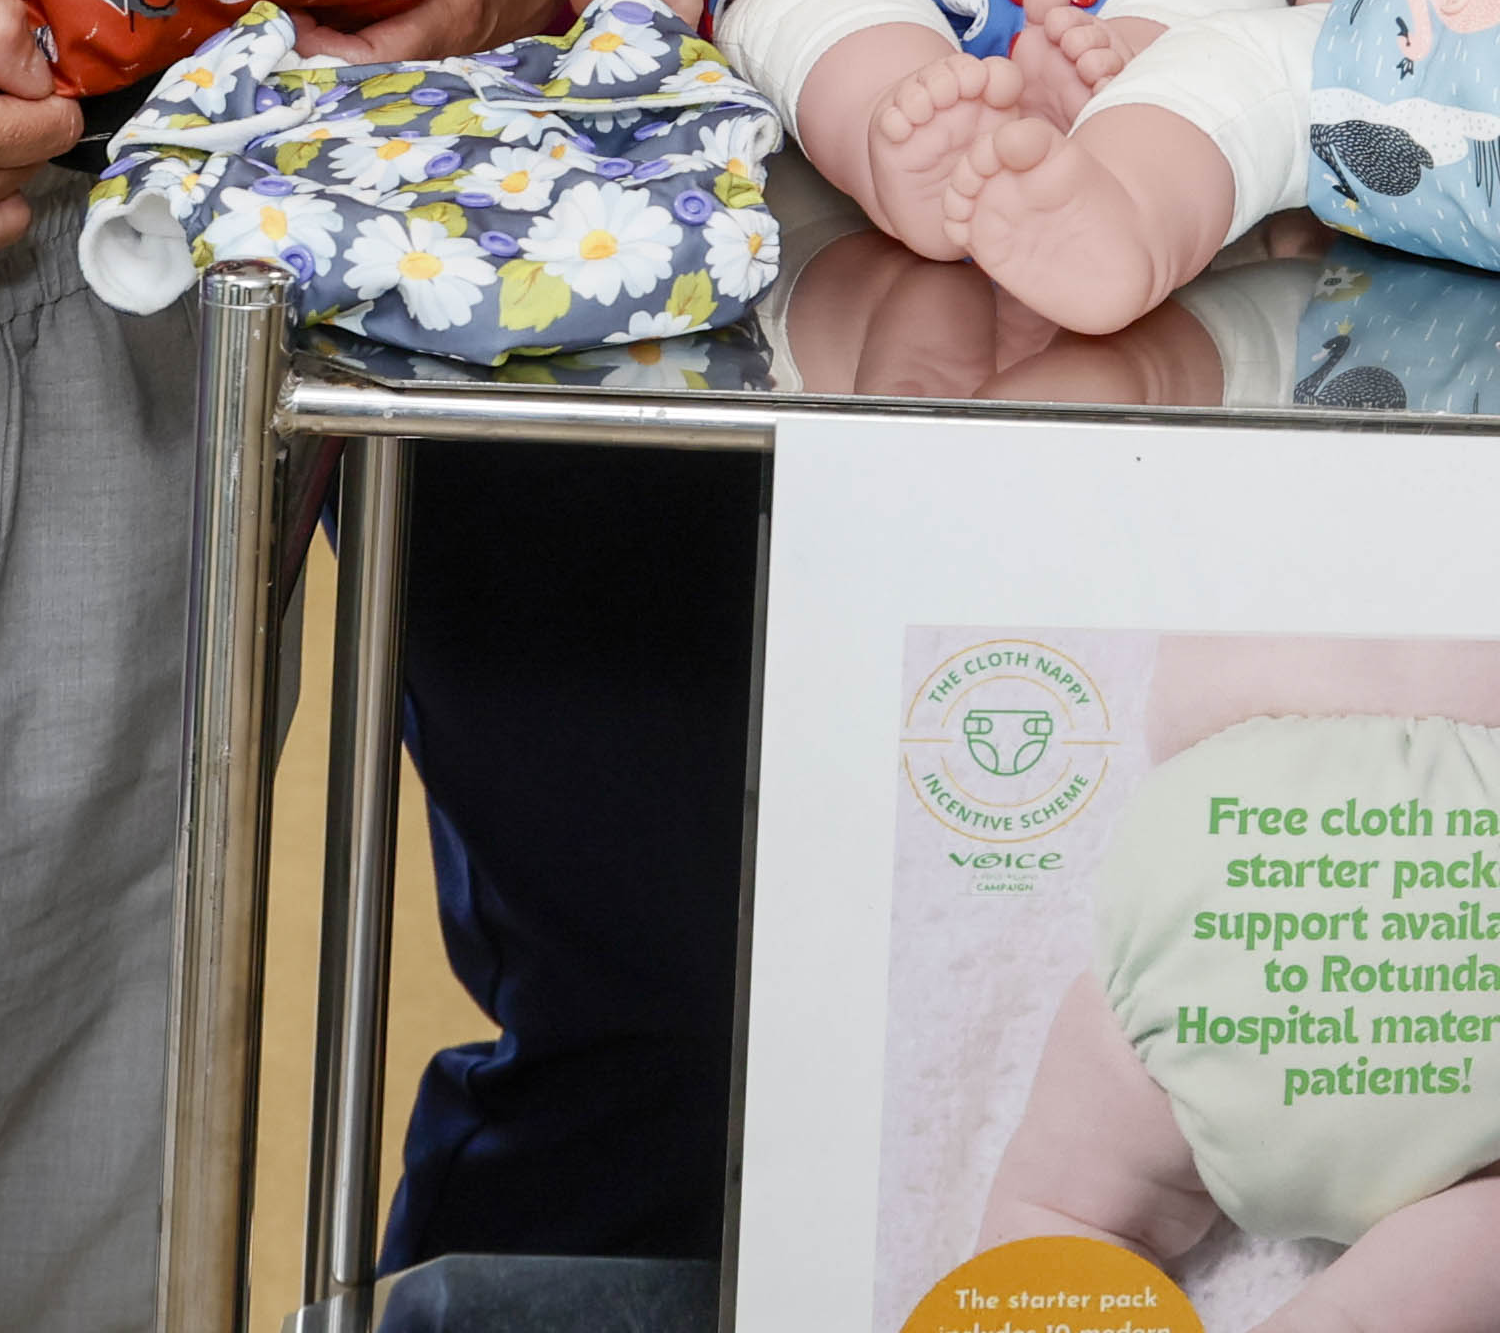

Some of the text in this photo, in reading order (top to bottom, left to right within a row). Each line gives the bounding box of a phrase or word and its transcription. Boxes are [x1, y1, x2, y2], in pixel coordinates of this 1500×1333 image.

[928, 651, 1090, 707] THE CLOTH NAPPY
[921, 772, 1089, 831] INCENTIVE SCHEME
[1208, 797, 1308, 836] Free
[1321, 798, 1434, 836] cloth
[1226, 853, 1379, 888] starter
[1193, 906, 1369, 951] support
[1264, 959, 1308, 992] to
[1176, 1004, 1359, 1055] Hospital
[1284, 1056, 1473, 1106] patients!
[955, 1286, 1158, 1312] The starter pack
